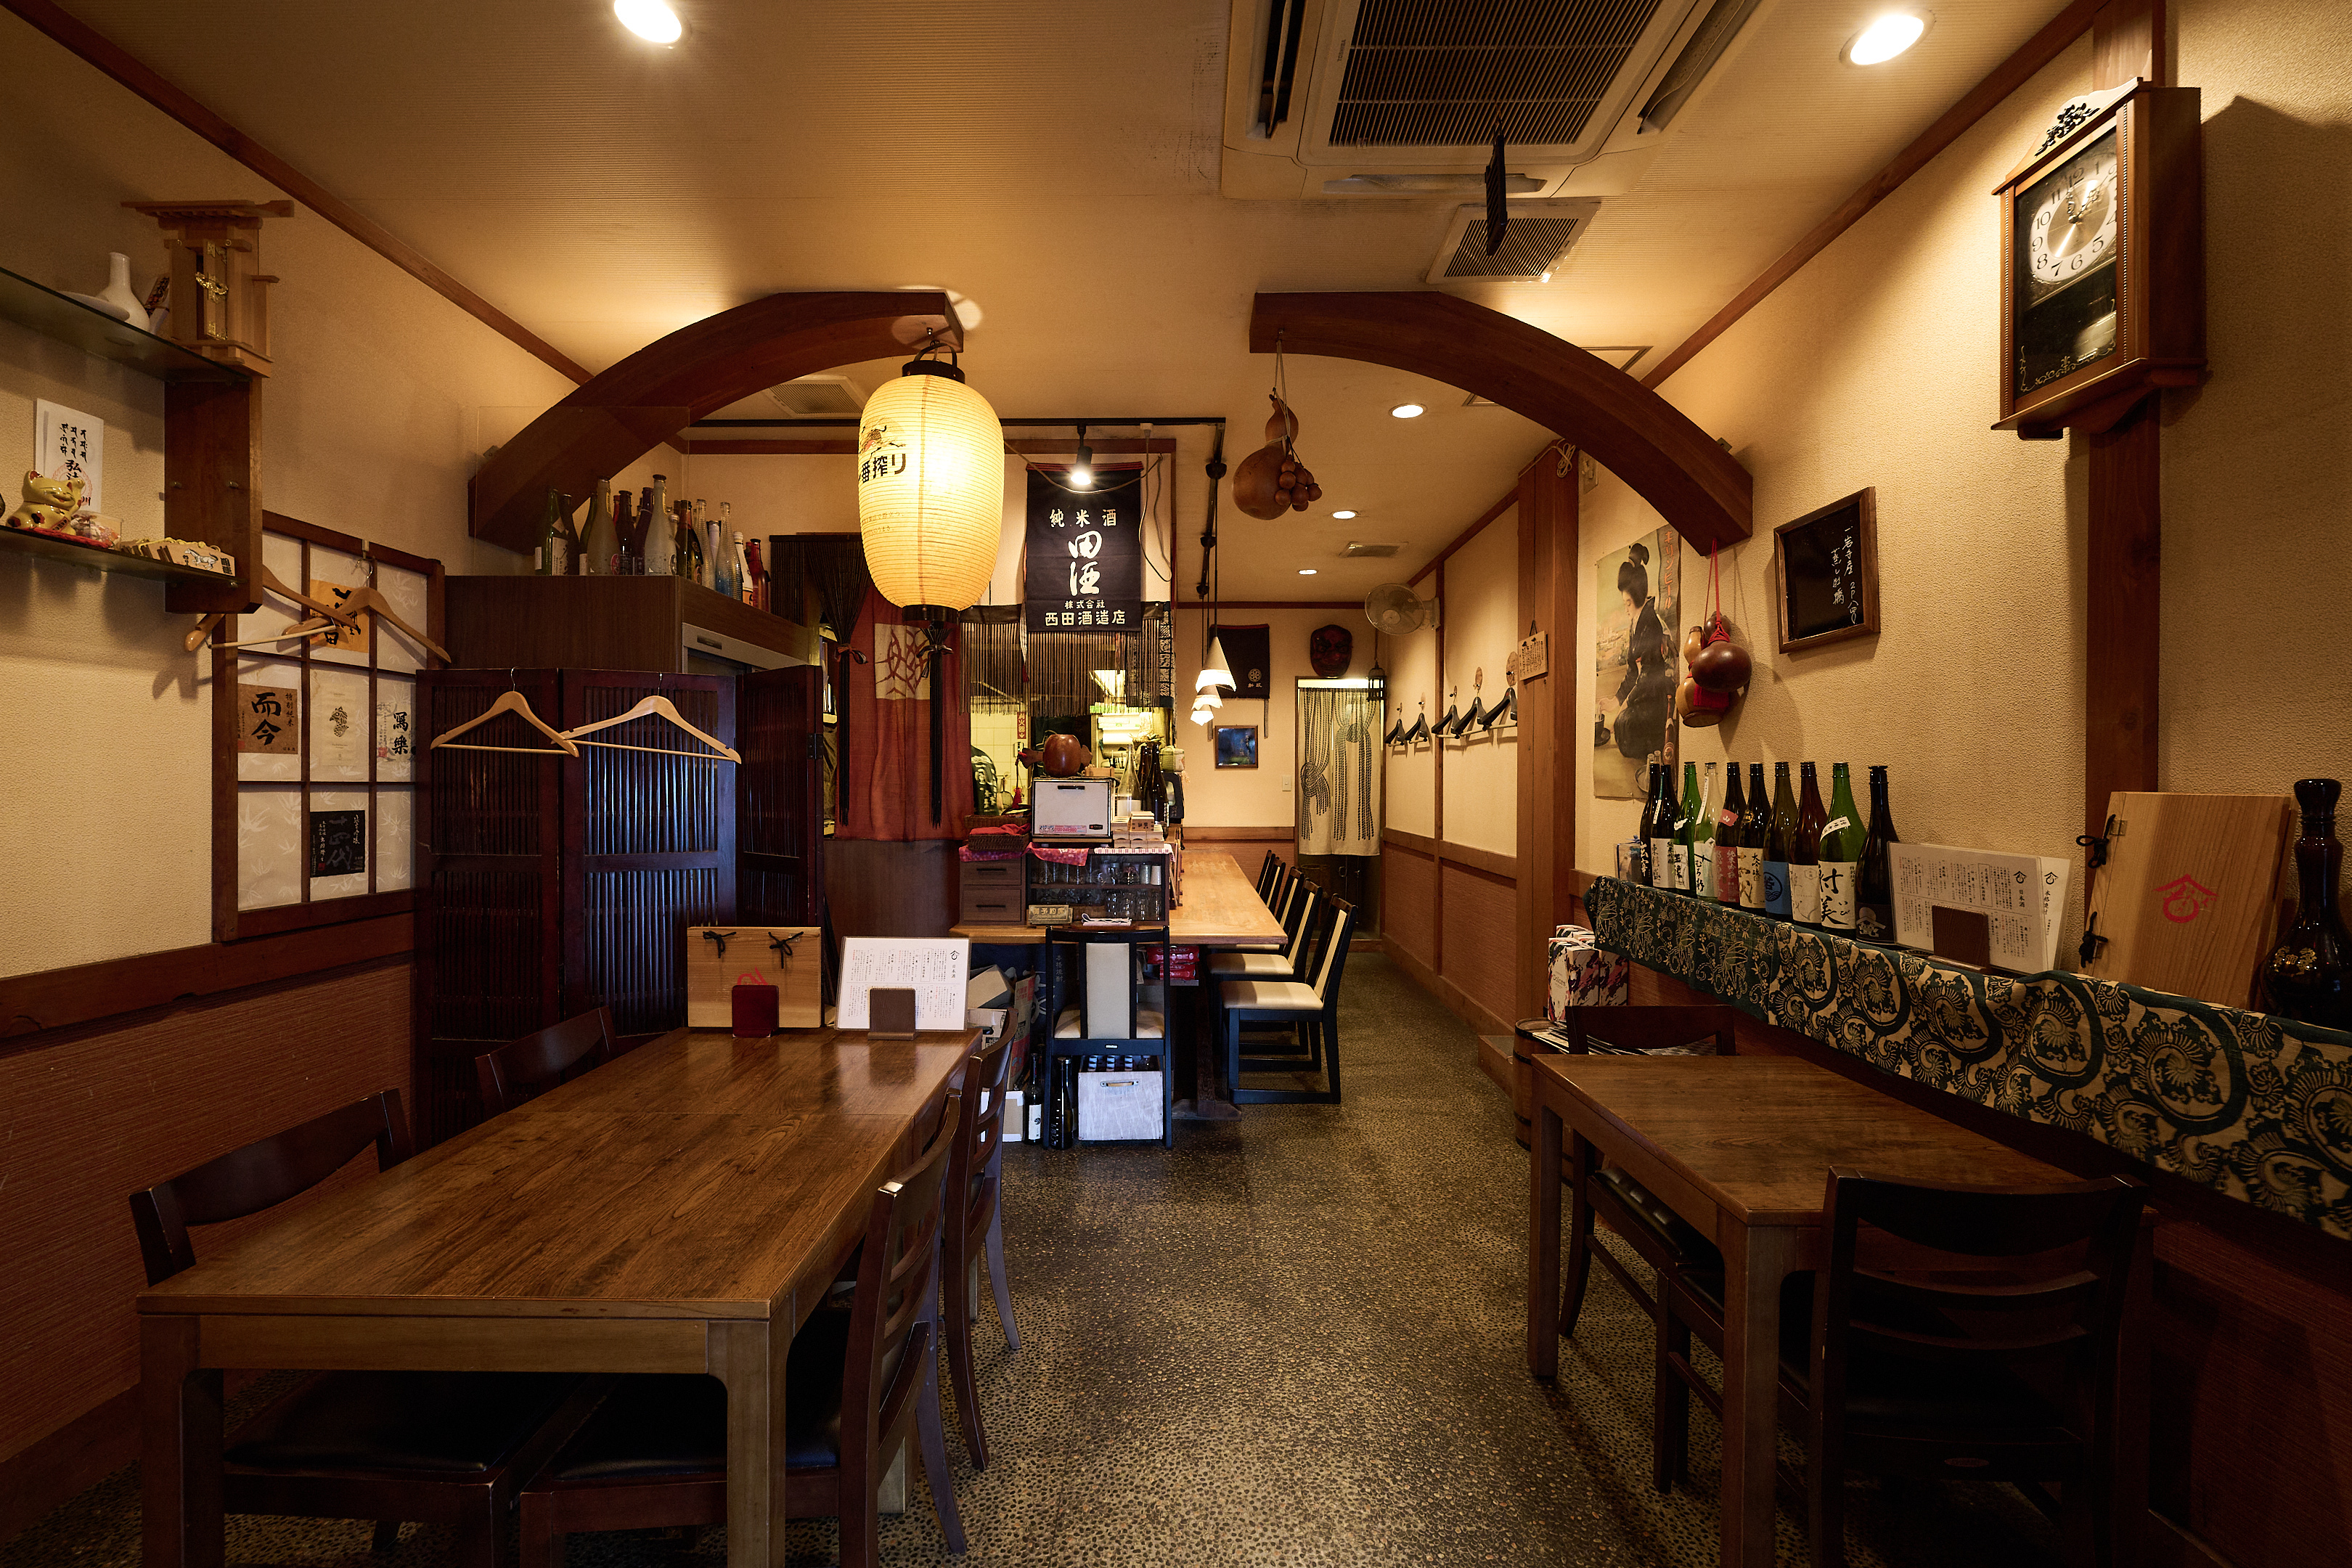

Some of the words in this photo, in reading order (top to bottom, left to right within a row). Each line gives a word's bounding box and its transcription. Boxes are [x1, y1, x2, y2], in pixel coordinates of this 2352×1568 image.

[1337, 39, 1347, 62] TOSHIBA
[2095, 160, 2099, 175] 1
[2066, 167, 2084, 188] 12
[2051, 188, 2060, 205] 11
[2035, 211, 2051, 229] 10
[2033, 236, 2043, 252] 9
[2092, 234, 2103, 253] 5
[2036, 253, 2048, 270] 8
[2051, 261, 2063, 277] 7
[2071, 254, 2083, 270] 6
[859, 454, 906, 483] 番搾り
[1050, 509, 1116, 528] 純米酒
[1068, 530, 1103, 597] 田酒
[1664, 531, 1675, 611] キリンビール
[1064, 600, 1106, 610] 株式会社
[1045, 609, 1126, 626] 西田酒造店
[251, 692, 282, 746] 而今
